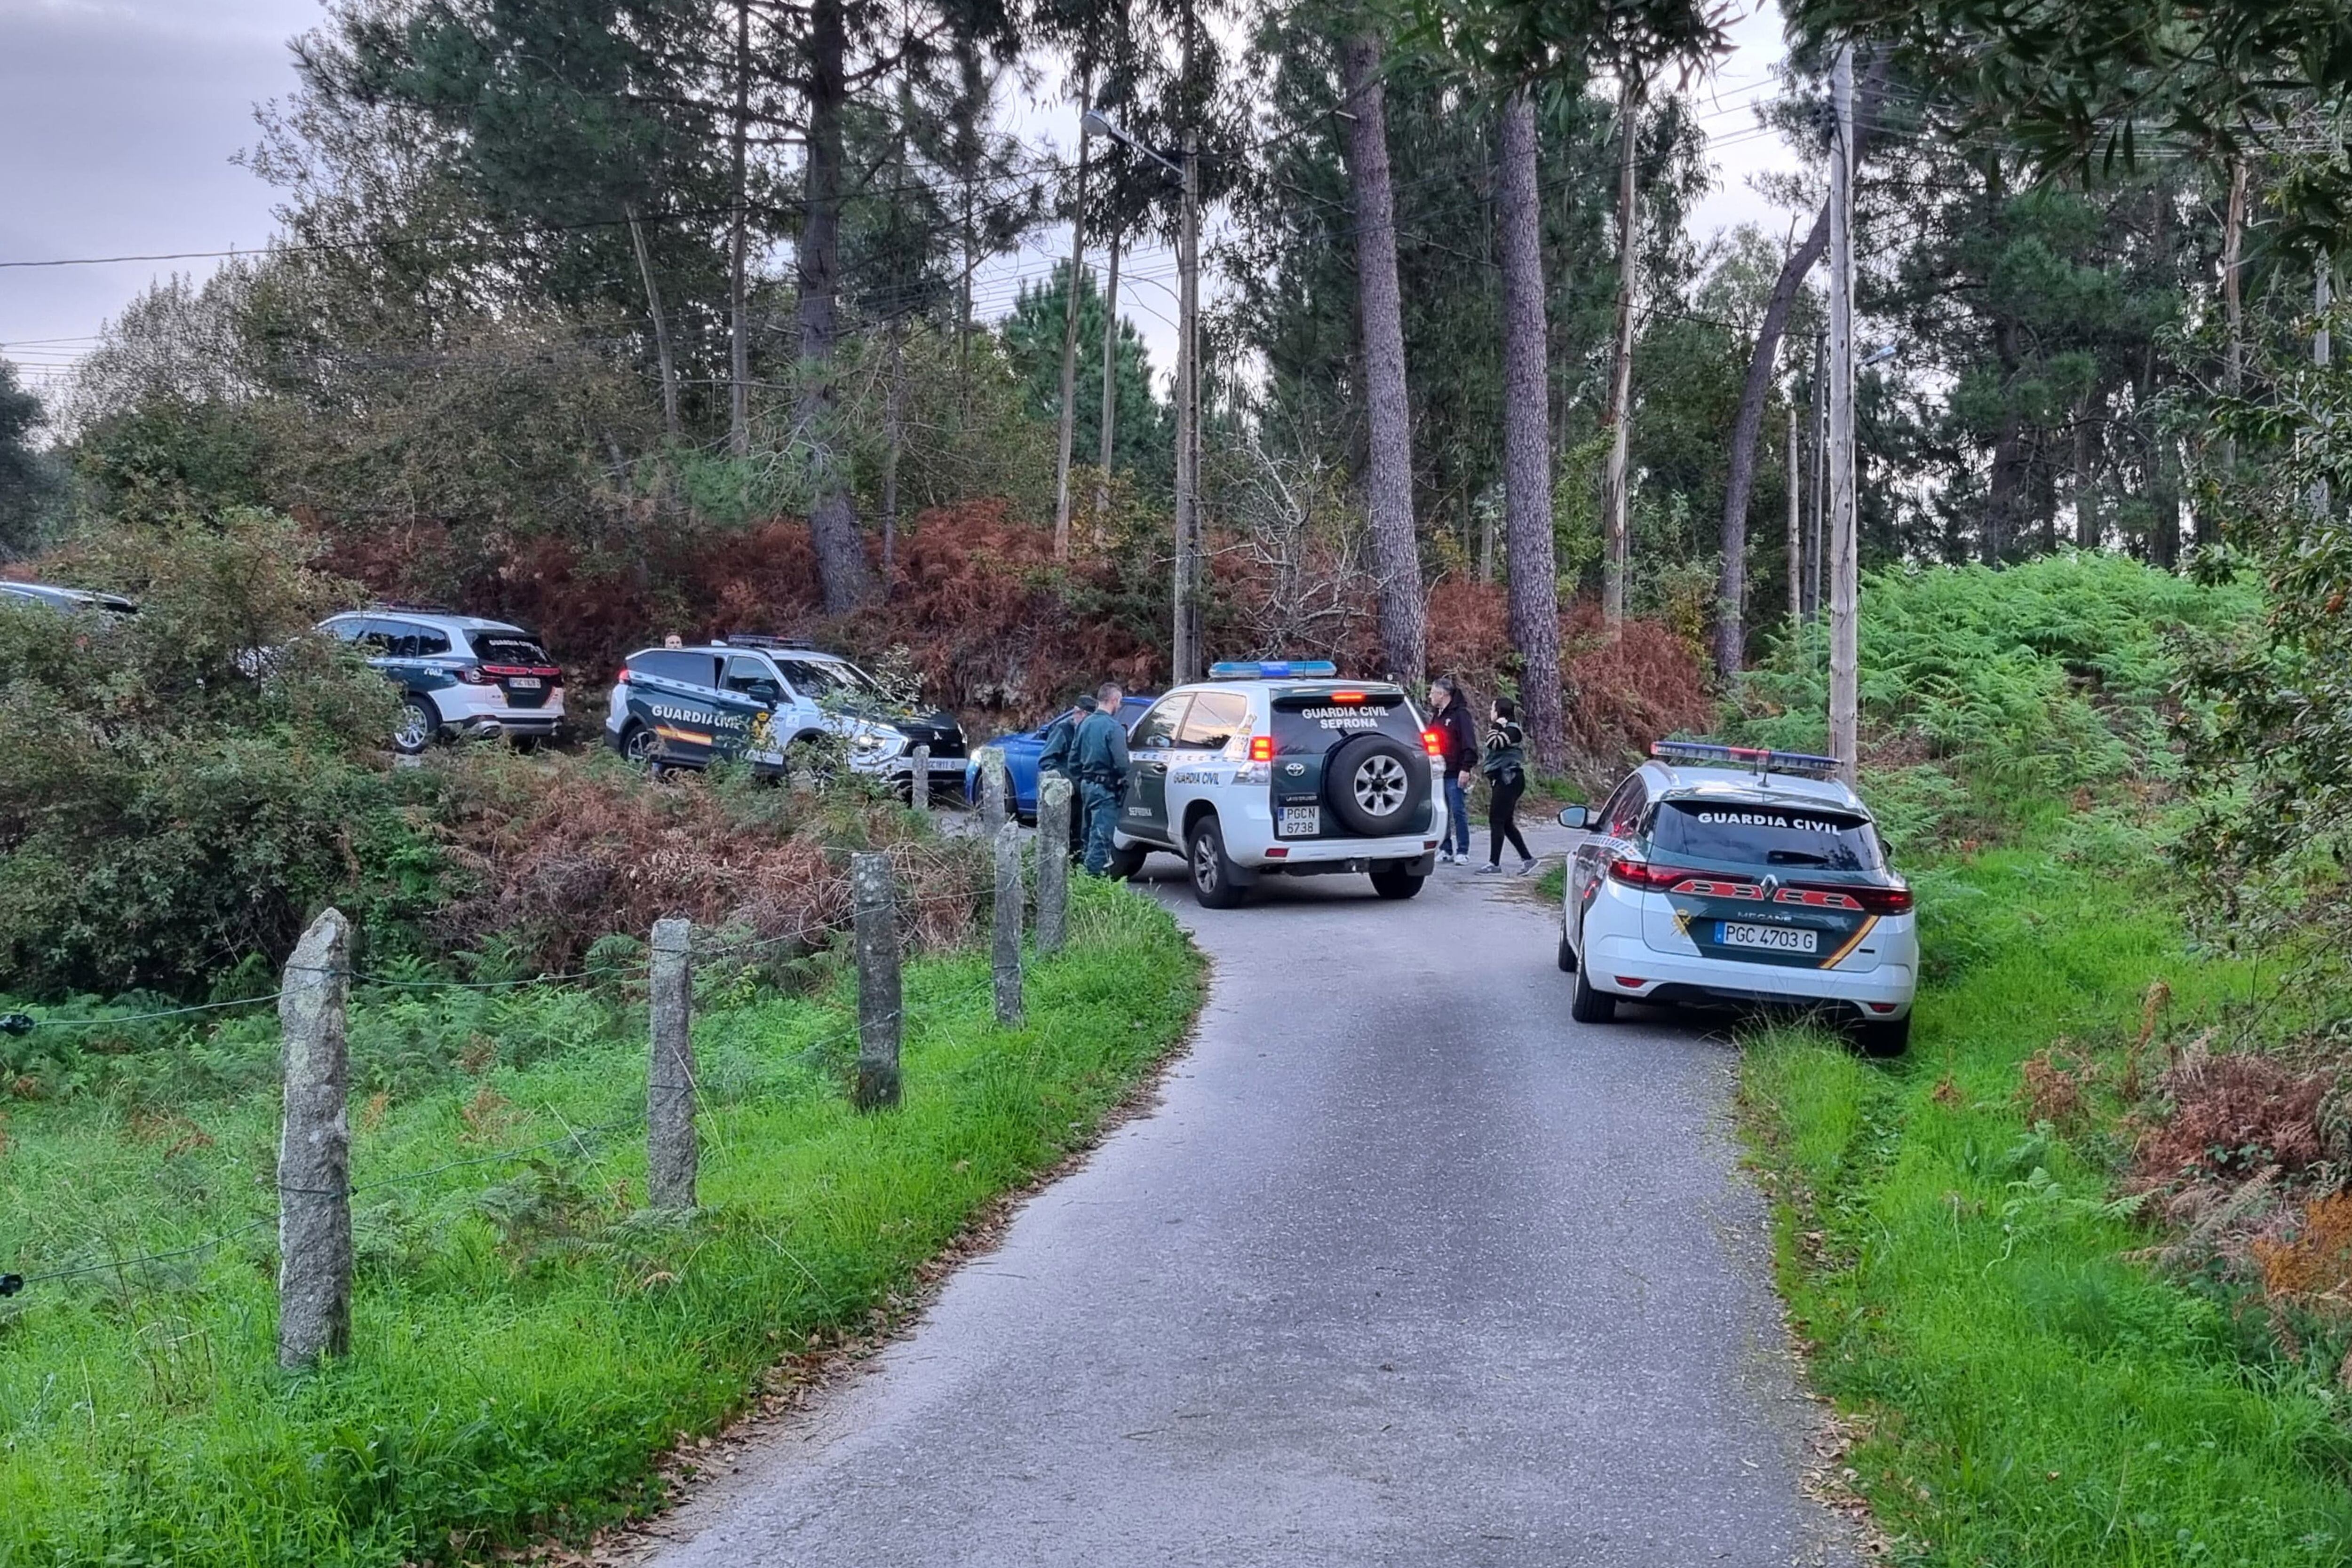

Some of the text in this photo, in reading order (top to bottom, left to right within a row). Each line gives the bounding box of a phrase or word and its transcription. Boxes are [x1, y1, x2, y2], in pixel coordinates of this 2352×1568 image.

[652, 705, 713, 725] GUARDIA
[1302, 706, 1389, 719] GUARDIA CIVIL
[1320, 718, 1378, 729] SEPRONA
[1173, 772, 1220, 785] GUARDIA CIVIL
[1287, 822, 1314, 833] 6738
[1698, 813, 1842, 836] GUARDIA CIVIL
[1726, 926, 1813, 949] PGC 4703 G
